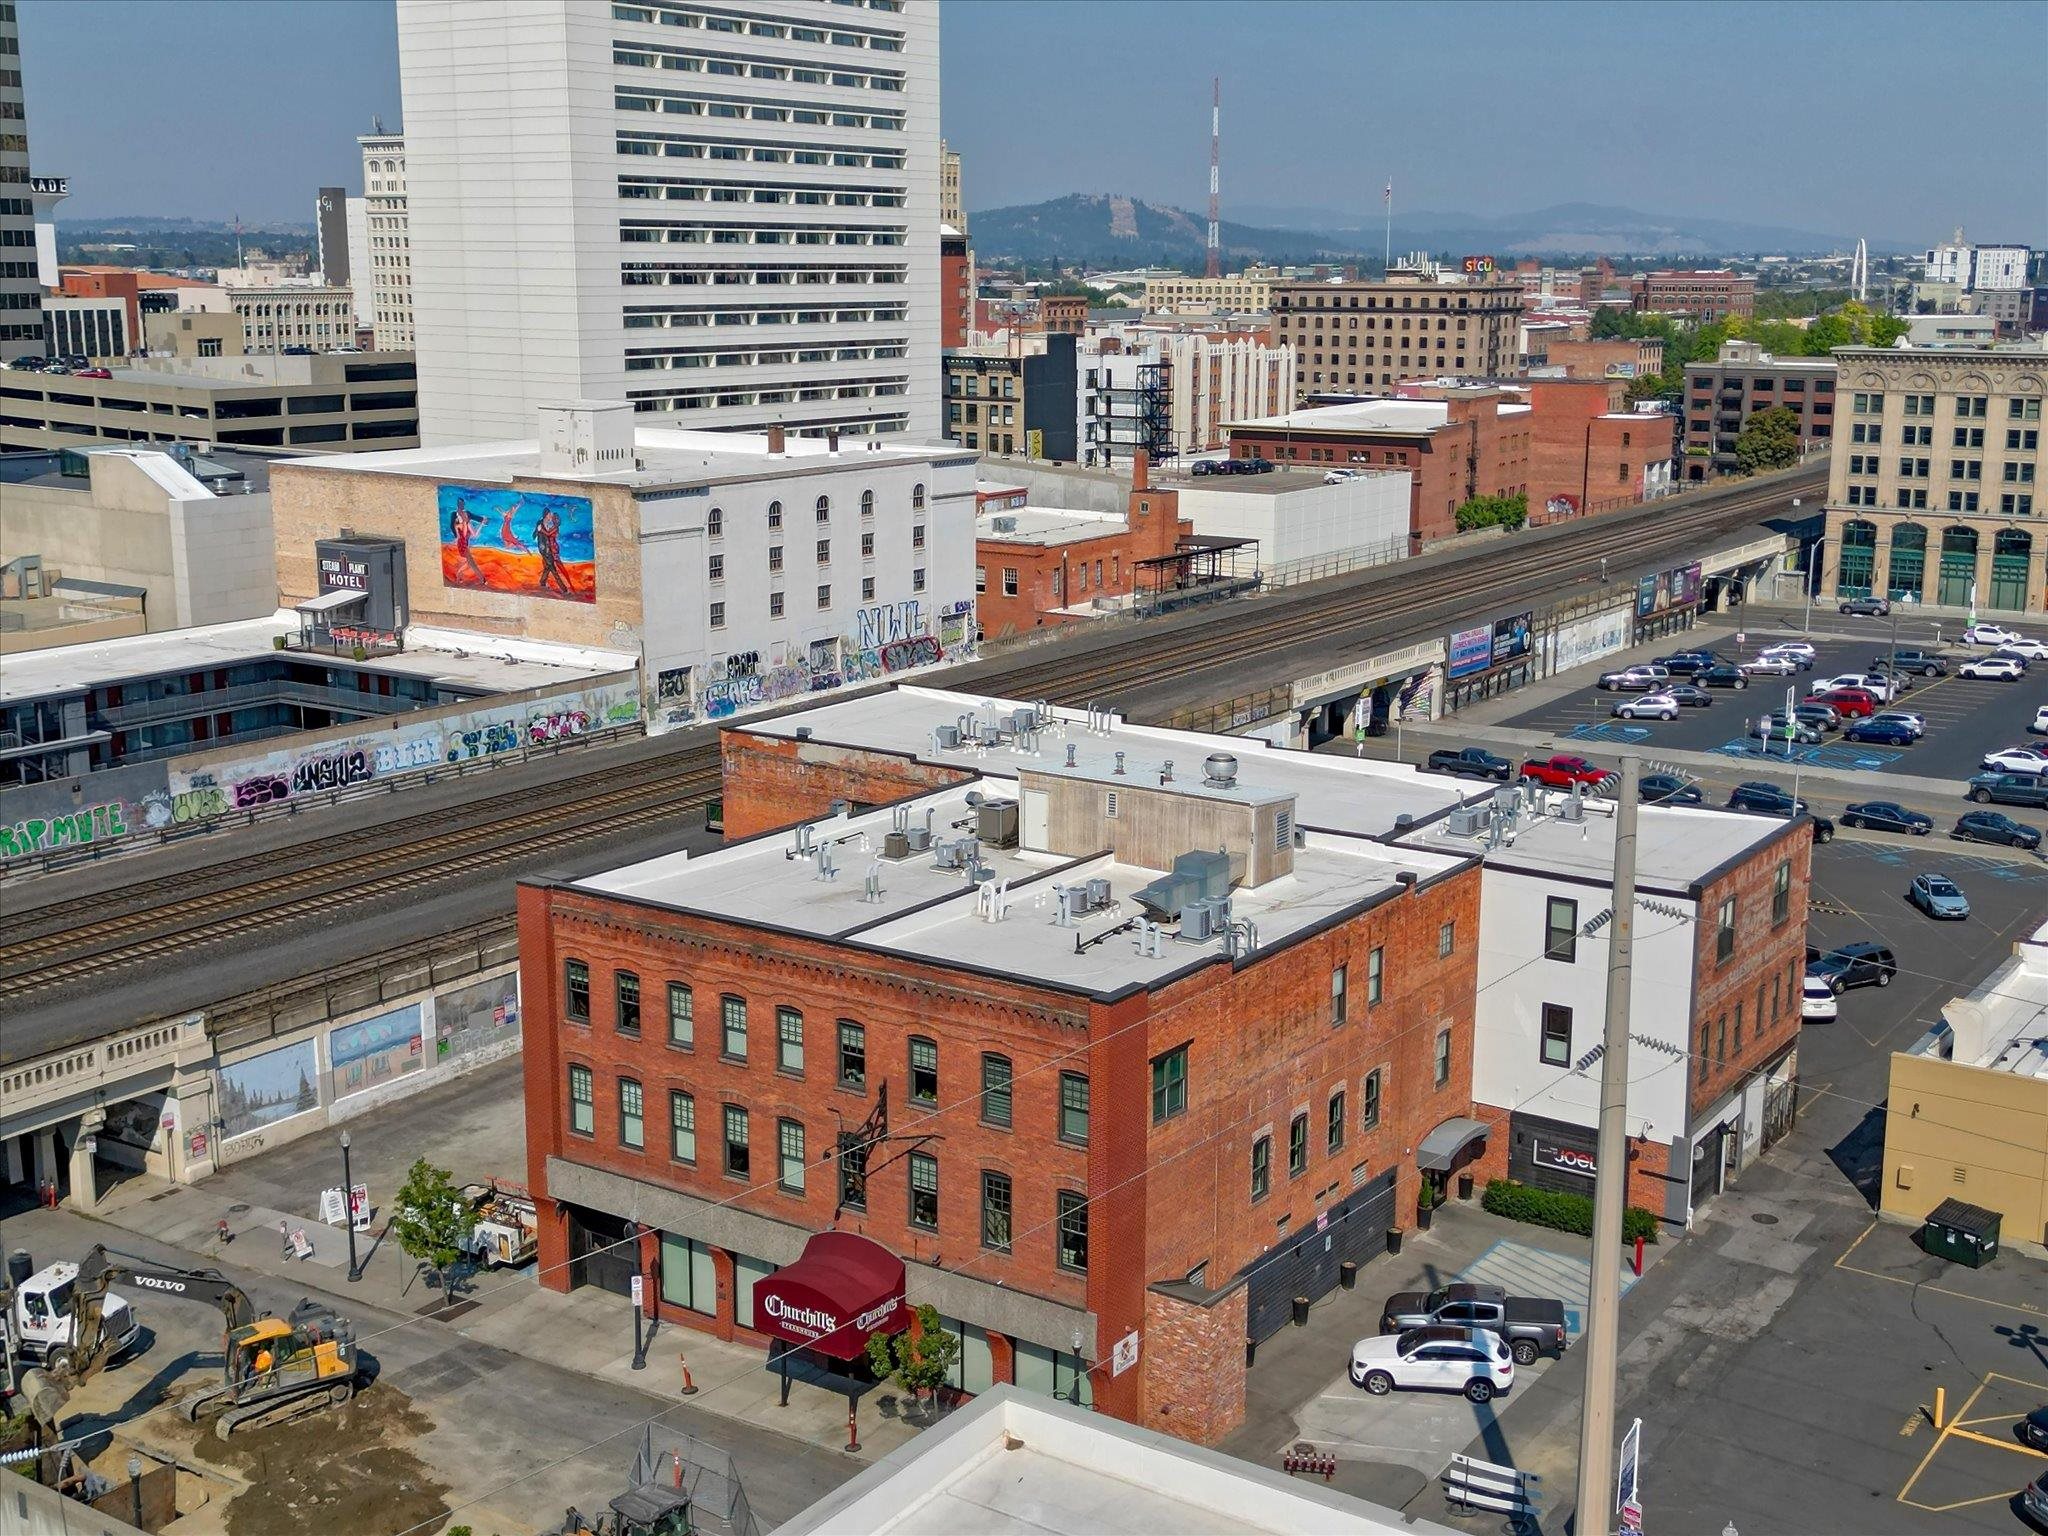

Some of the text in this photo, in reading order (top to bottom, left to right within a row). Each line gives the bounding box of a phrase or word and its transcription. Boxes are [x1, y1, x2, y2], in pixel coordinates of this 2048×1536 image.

[329, 574, 362, 587] HOTEL
[50, 801, 128, 846] MUTE
[134, 1275, 186, 1291] VOLVO
[764, 1294, 837, 1332] Churchill's
